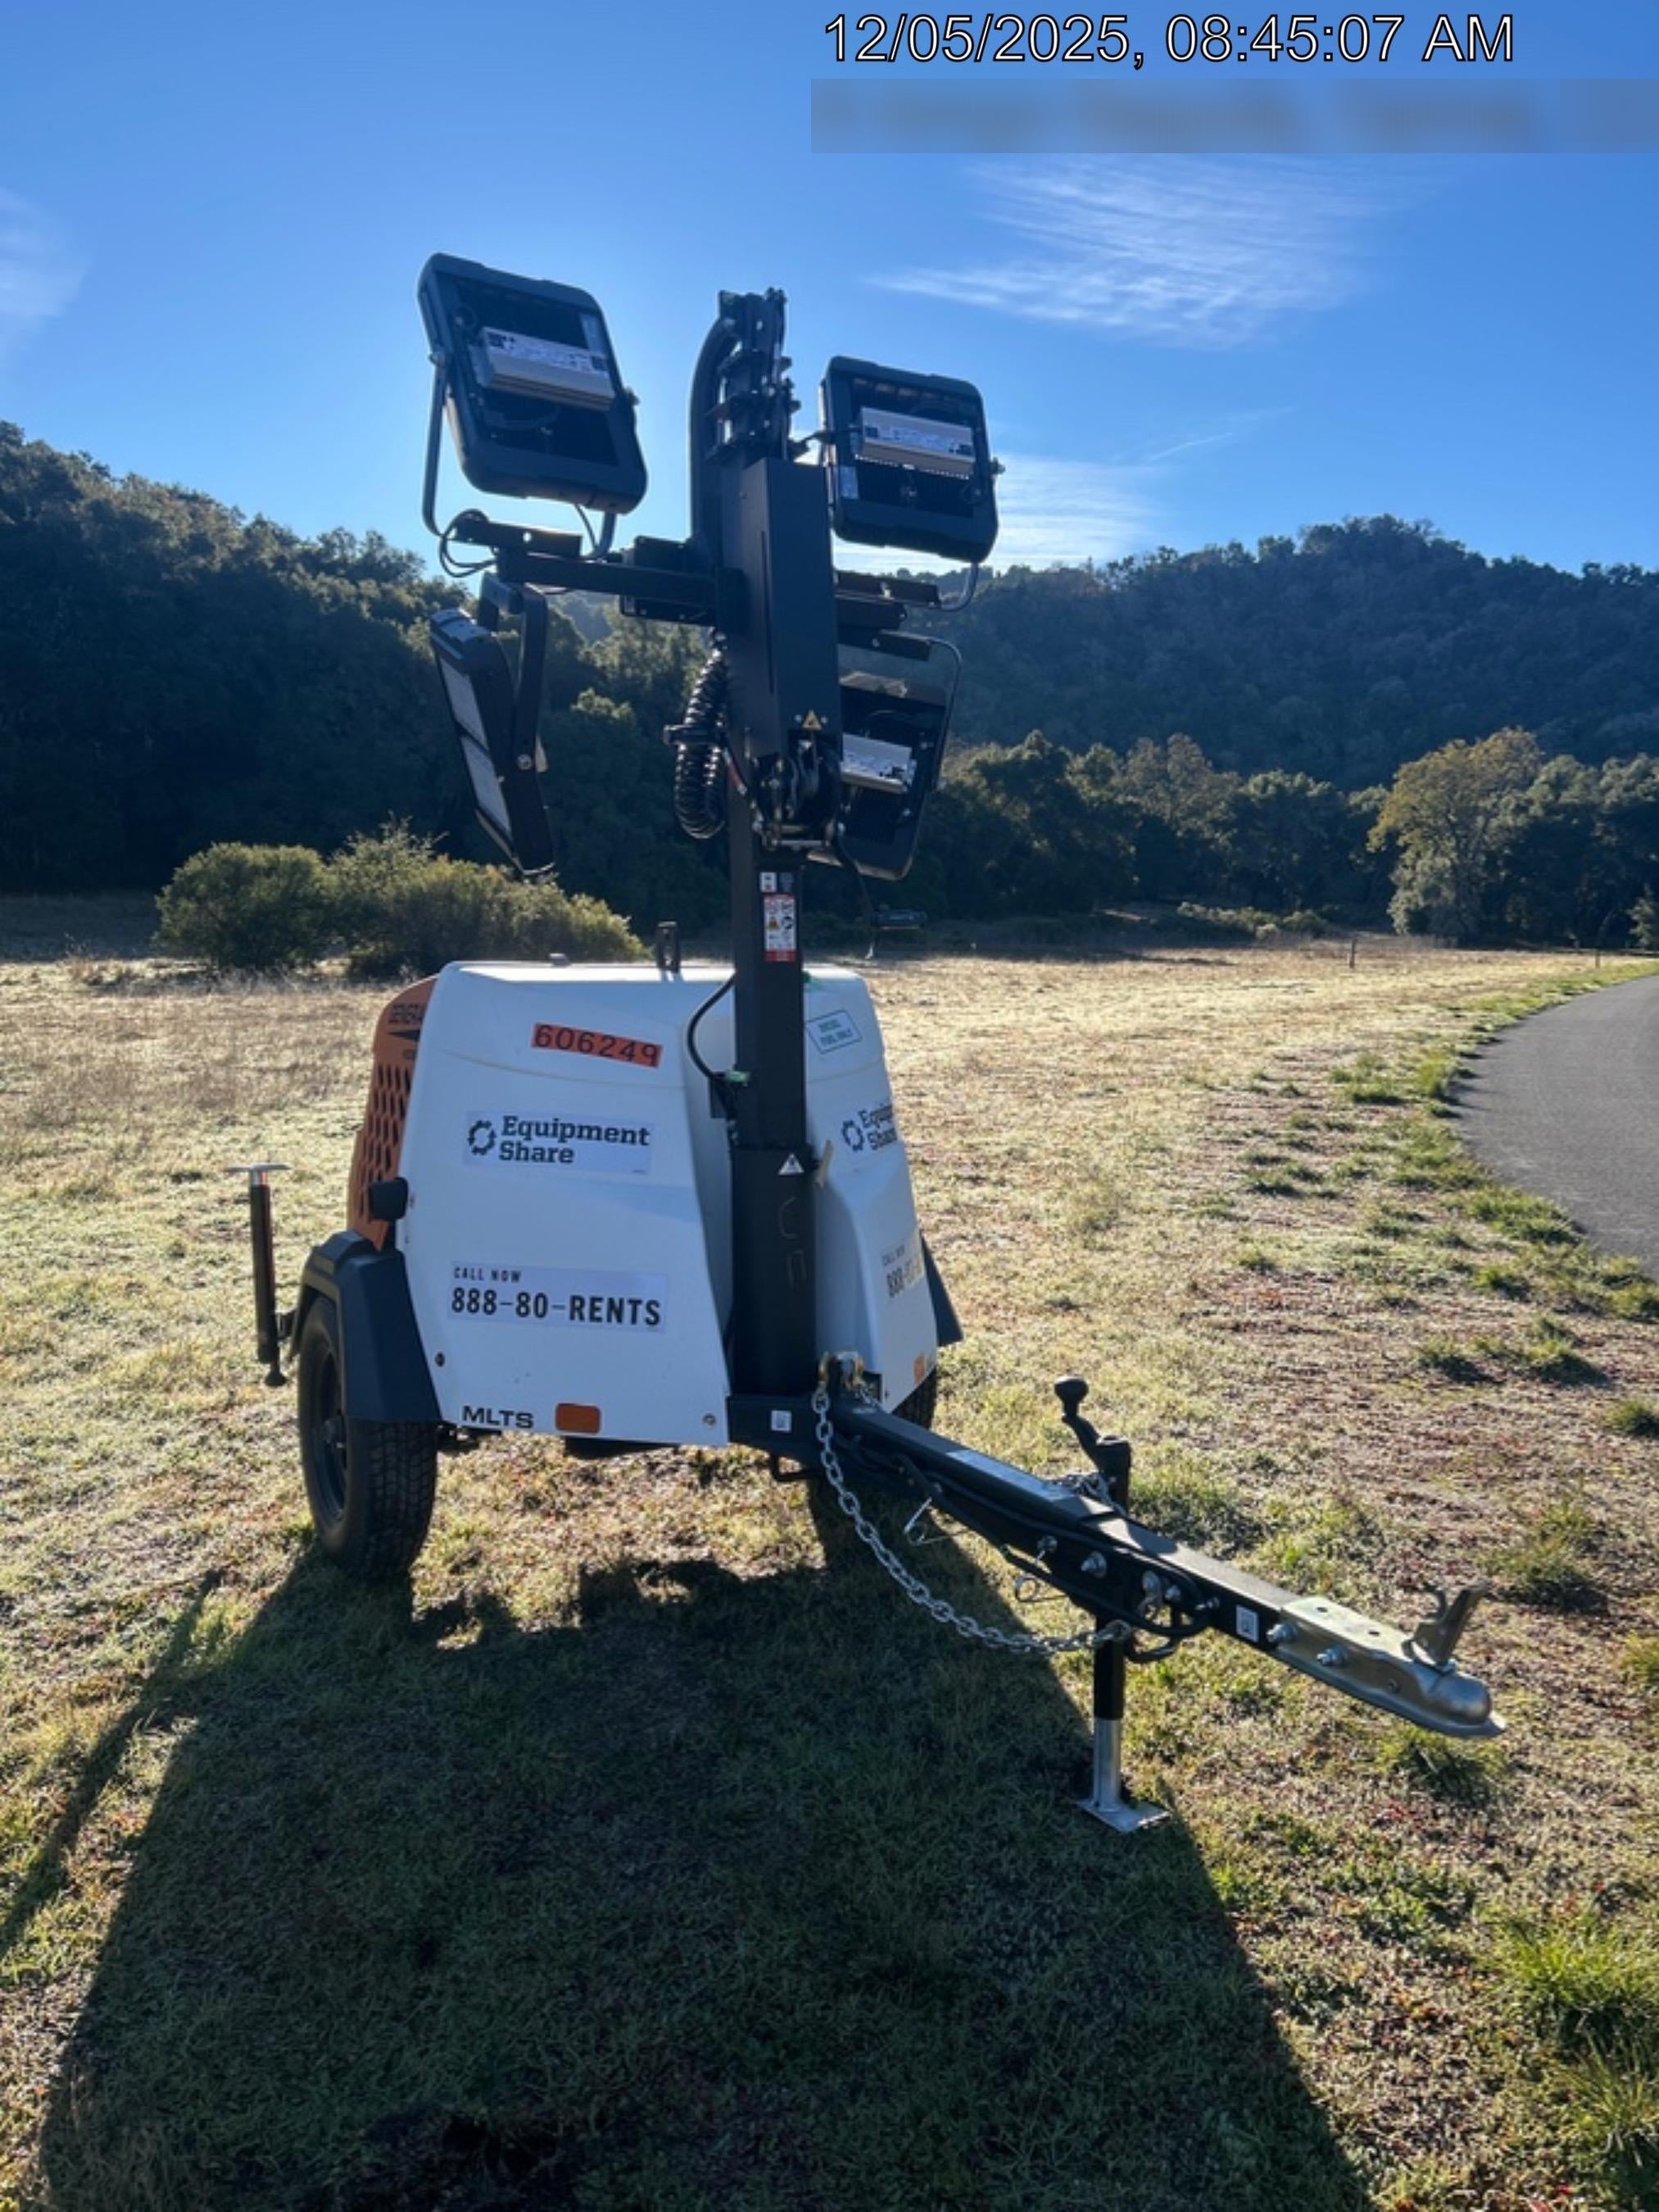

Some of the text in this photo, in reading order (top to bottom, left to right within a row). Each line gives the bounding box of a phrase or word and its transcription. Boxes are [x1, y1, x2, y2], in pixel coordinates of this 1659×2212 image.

[534, 1024, 659, 1067] 606249
[501, 1115, 650, 1146] Equipment
[499, 1140, 574, 1163] Share
[454, 1267, 522, 1283] CALL NOW
[451, 1287, 660, 1326] 888-80-RENTS
[462, 1405, 534, 1429] MLTS
